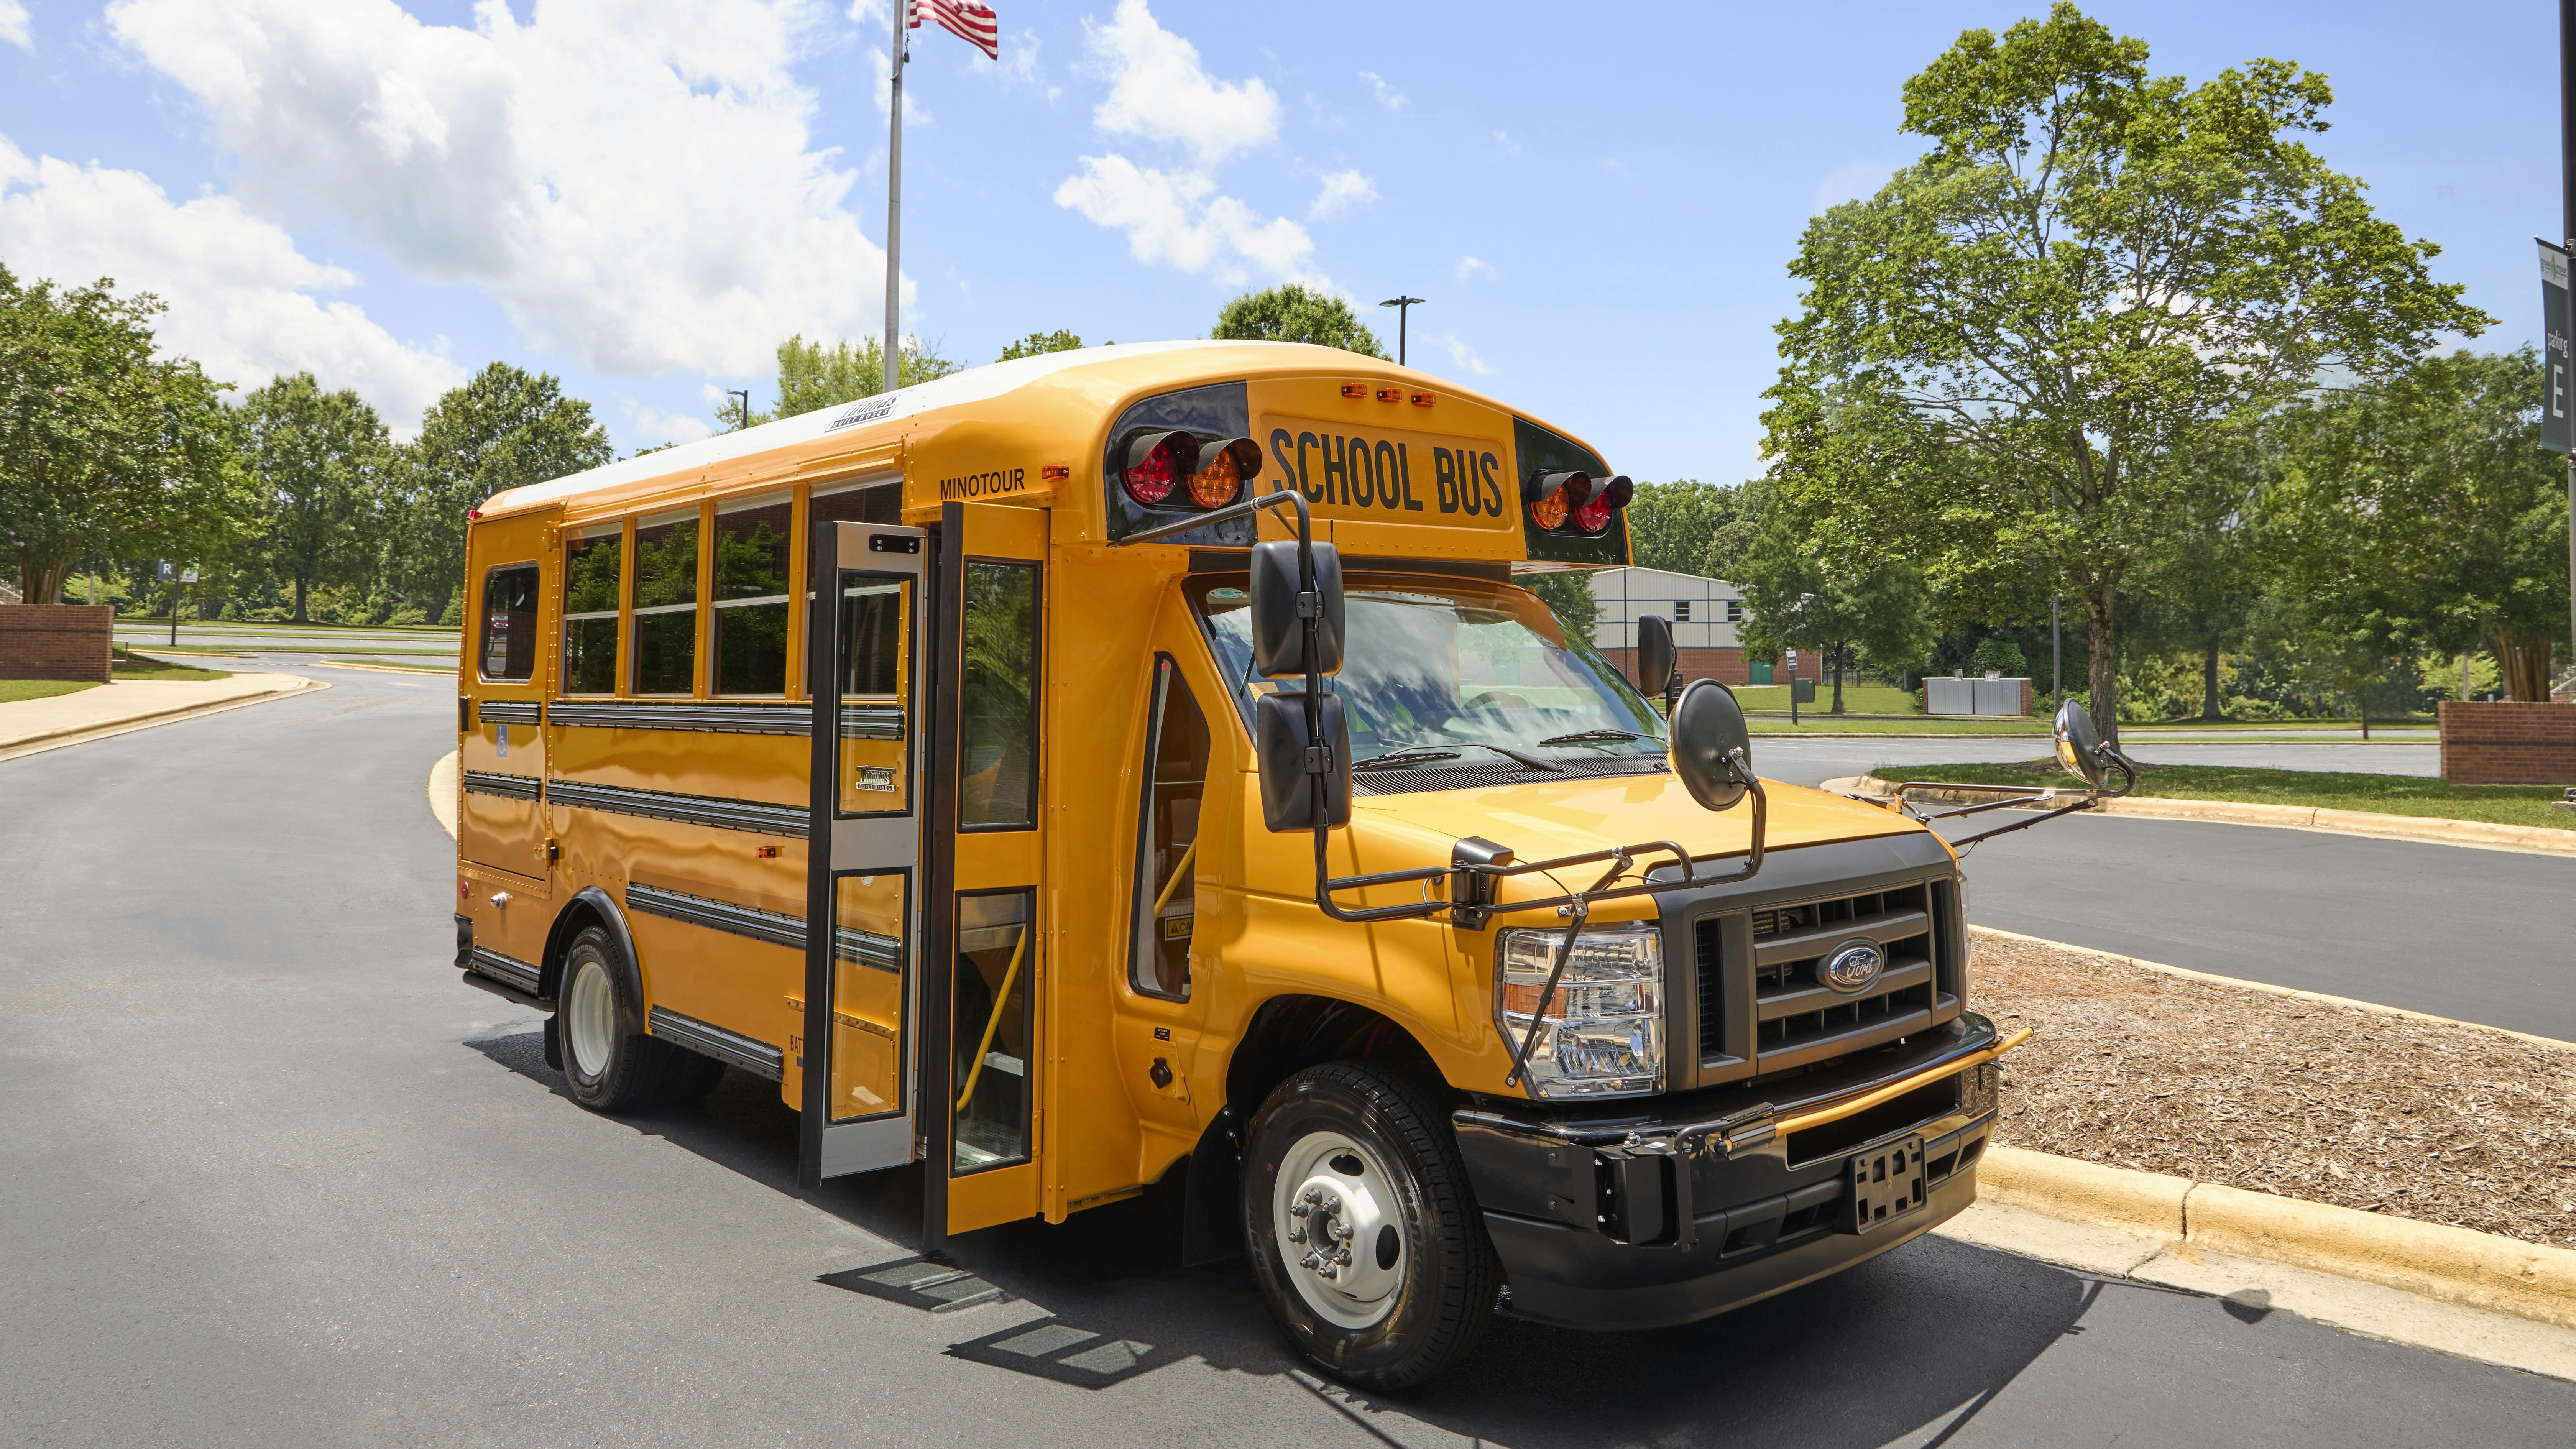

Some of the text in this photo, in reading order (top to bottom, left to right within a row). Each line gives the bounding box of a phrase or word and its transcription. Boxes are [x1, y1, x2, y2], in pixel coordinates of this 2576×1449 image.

[2553, 364, 2564, 418] E
[833, 408, 889, 427] BUILT BUSES
[841, 394, 902, 418] Thomas
[940, 468, 1025, 500] MINOTOUR
[1269, 428, 1503, 518] SCHOOL BUS
[163, 564, 172, 574] R
[858, 765, 894, 785] Thomas
[1179, 922, 1193, 932] CA
[1846, 954, 1873, 978] Ford
